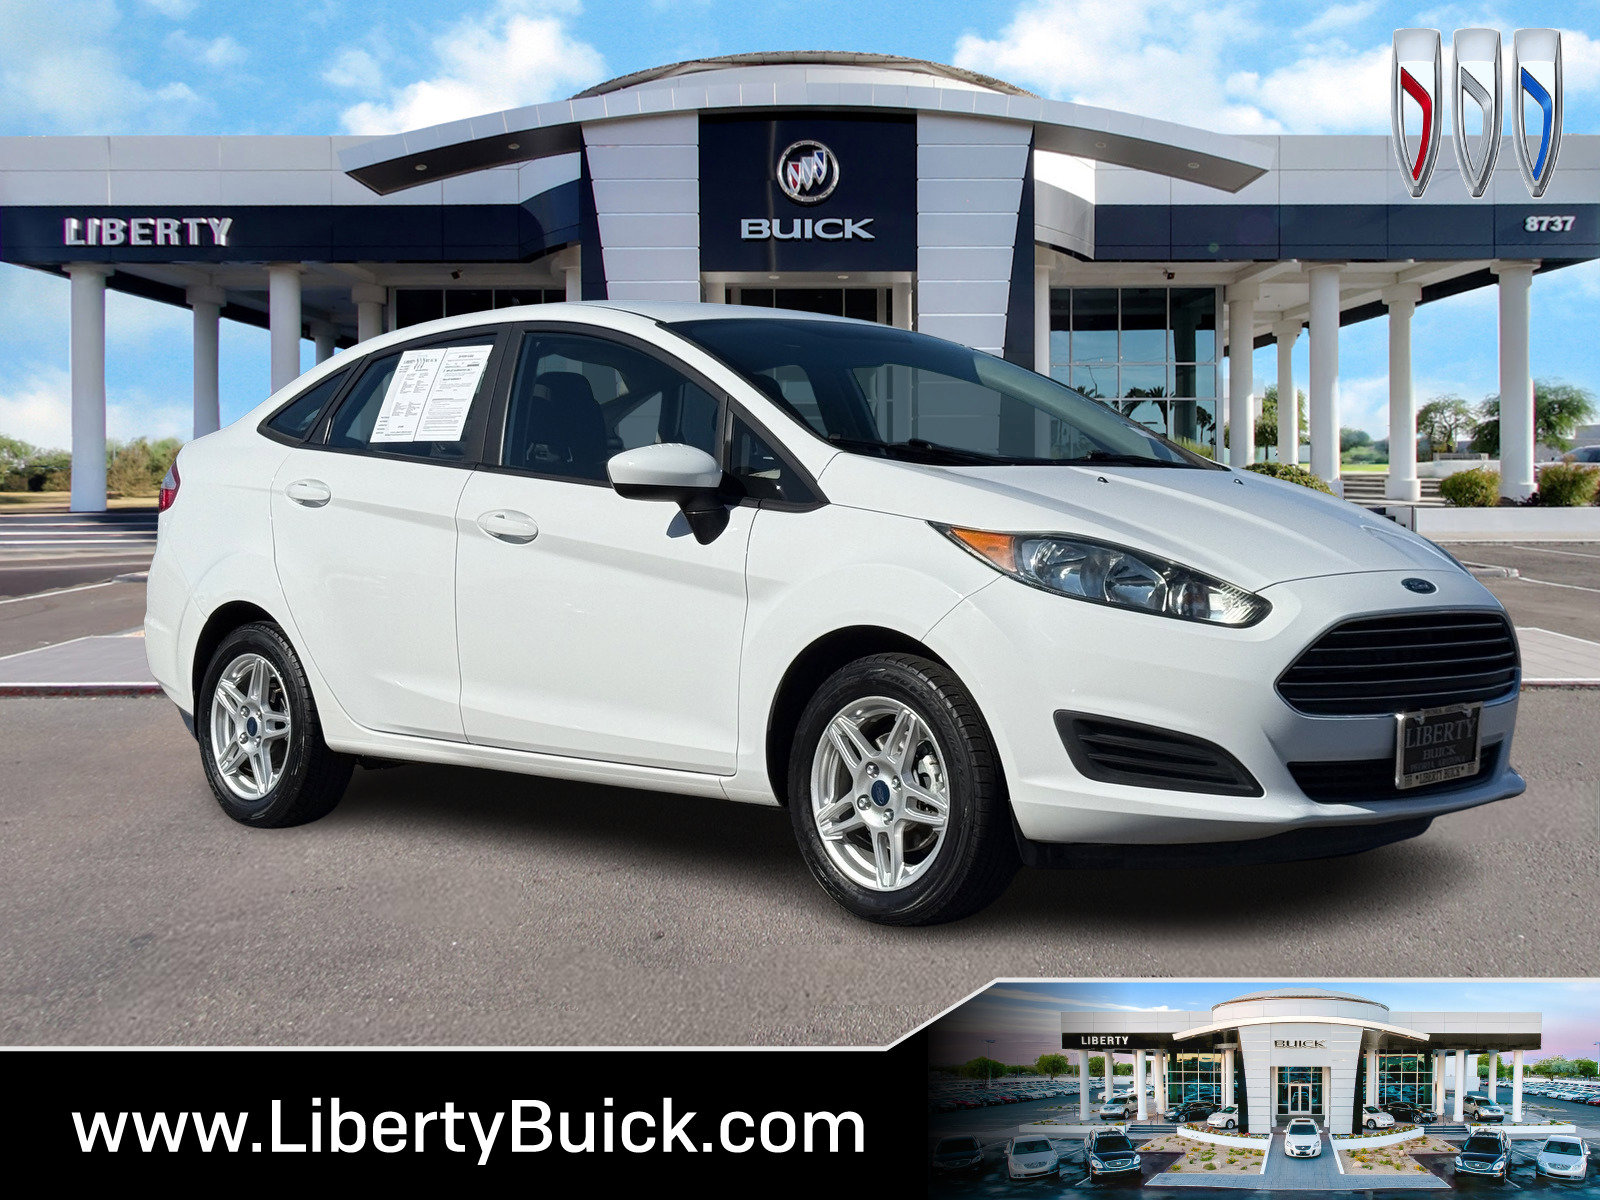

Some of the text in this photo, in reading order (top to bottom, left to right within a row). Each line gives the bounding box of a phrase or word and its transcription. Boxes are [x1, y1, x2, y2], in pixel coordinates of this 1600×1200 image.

[64, 217, 233, 247] LIBERTY
[740, 218, 876, 240] BUICK
[1524, 215, 1576, 232] 8737
[1405, 717, 1477, 749] LIBERTY
[1423, 745, 1457, 760] BUICK
[1081, 1036, 1129, 1046] LIBERTY
[1274, 1039, 1326, 1049] BUICK
